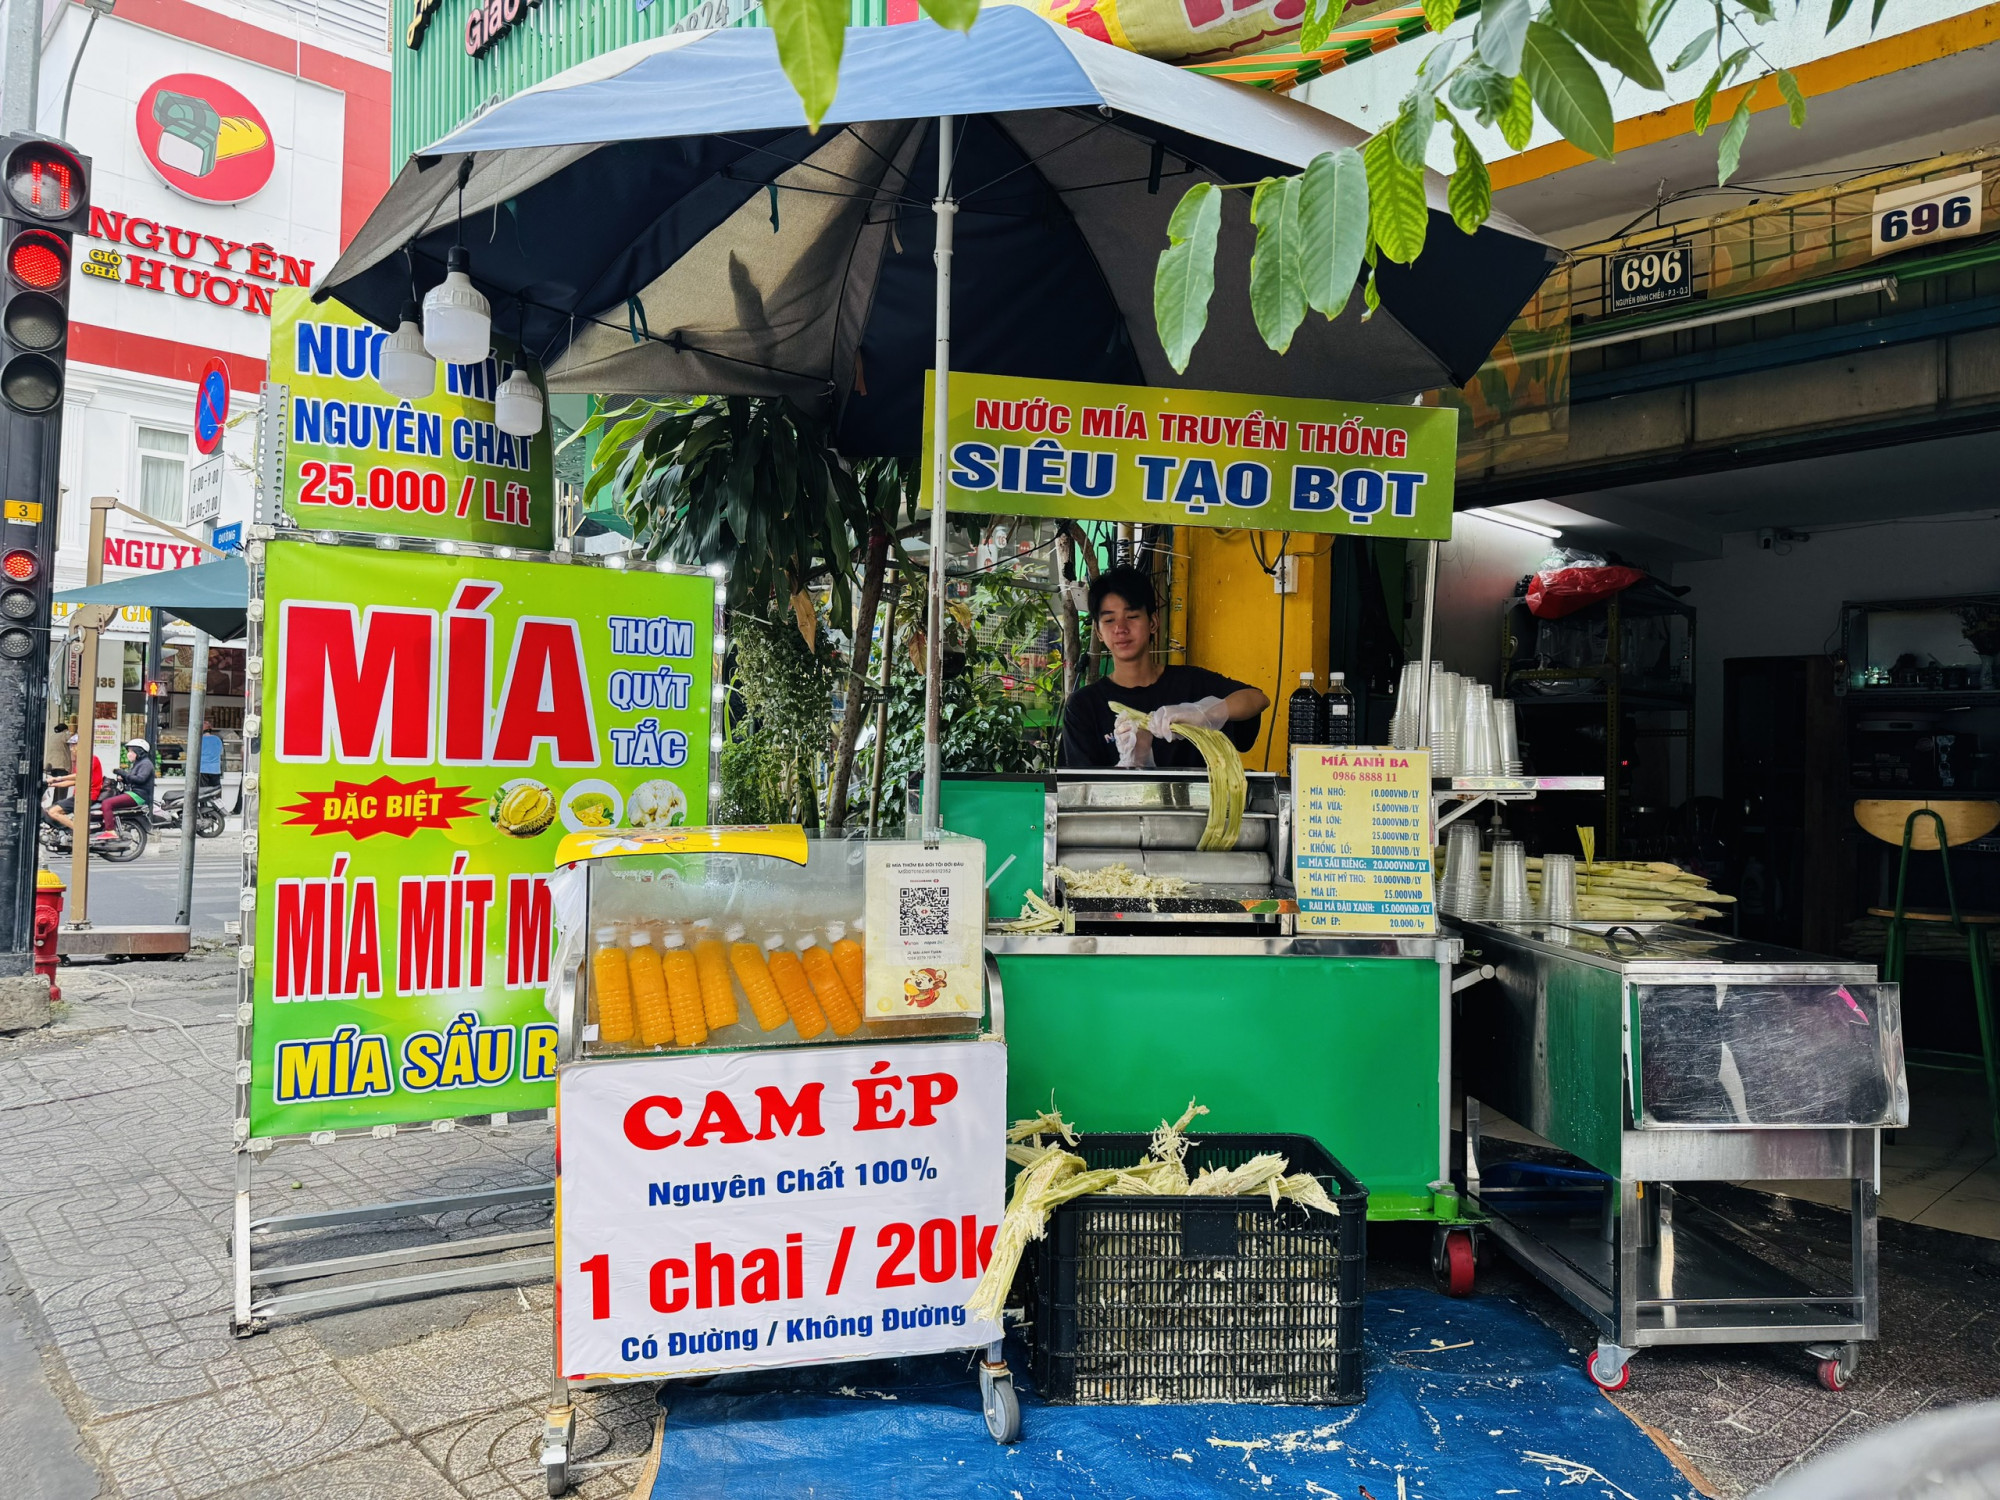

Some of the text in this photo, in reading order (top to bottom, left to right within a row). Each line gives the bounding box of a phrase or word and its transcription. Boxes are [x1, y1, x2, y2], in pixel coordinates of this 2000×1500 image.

[31, 161, 71, 211] 17
[1880, 195, 1971, 242] 696
[88, 205, 315, 287] NGUYÊN
[89, 248, 122, 266] GIÒ
[1621, 250, 1682, 292] 696
[294, 398, 441, 457] NGUYÊN
[975, 397, 1407, 458] NƯỚC MÍA TRUYỀN THỐNG
[300, 462, 530, 526] 25.000 / Lít
[949, 440, 1427, 525] SIÊU TẠO BỌT
[19, 504, 29, 517] 3
[608, 615, 695, 658] THƠM
[280, 582, 598, 765] MÍA
[608, 666, 693, 710] QUÝT
[610, 718, 688, 768] TẮC
[1321, 755, 1409, 768] MÍA ANH BA
[1310, 785, 1323, 796] MÍA
[1332, 771, 1397, 782] 0986 8888 11
[322, 787, 444, 822] ĐẶC BIỆT
[1309, 815, 1322, 824] MÍA
[1310, 800, 1322, 810] MÍA
[1308, 857, 1323, 867] MÍA
[1309, 873, 1322, 882] MÍA
[1311, 887, 1324, 897] MÍA
[274, 856, 381, 998] MÍA
[398, 855, 494, 991] MÍT
[1311, 916, 1327, 925] CAM
[278, 1027, 392, 1102] MÍA
[402, 1012, 513, 1089] SẦU
[623, 1061, 959, 1151] CAM ÉP
[648, 1156, 938, 1206] Nguyên Chất 100%
[580, 1214, 999, 1320] 1 chai / 20k
[621, 1305, 966, 1362] Có Đường / Không Đường
